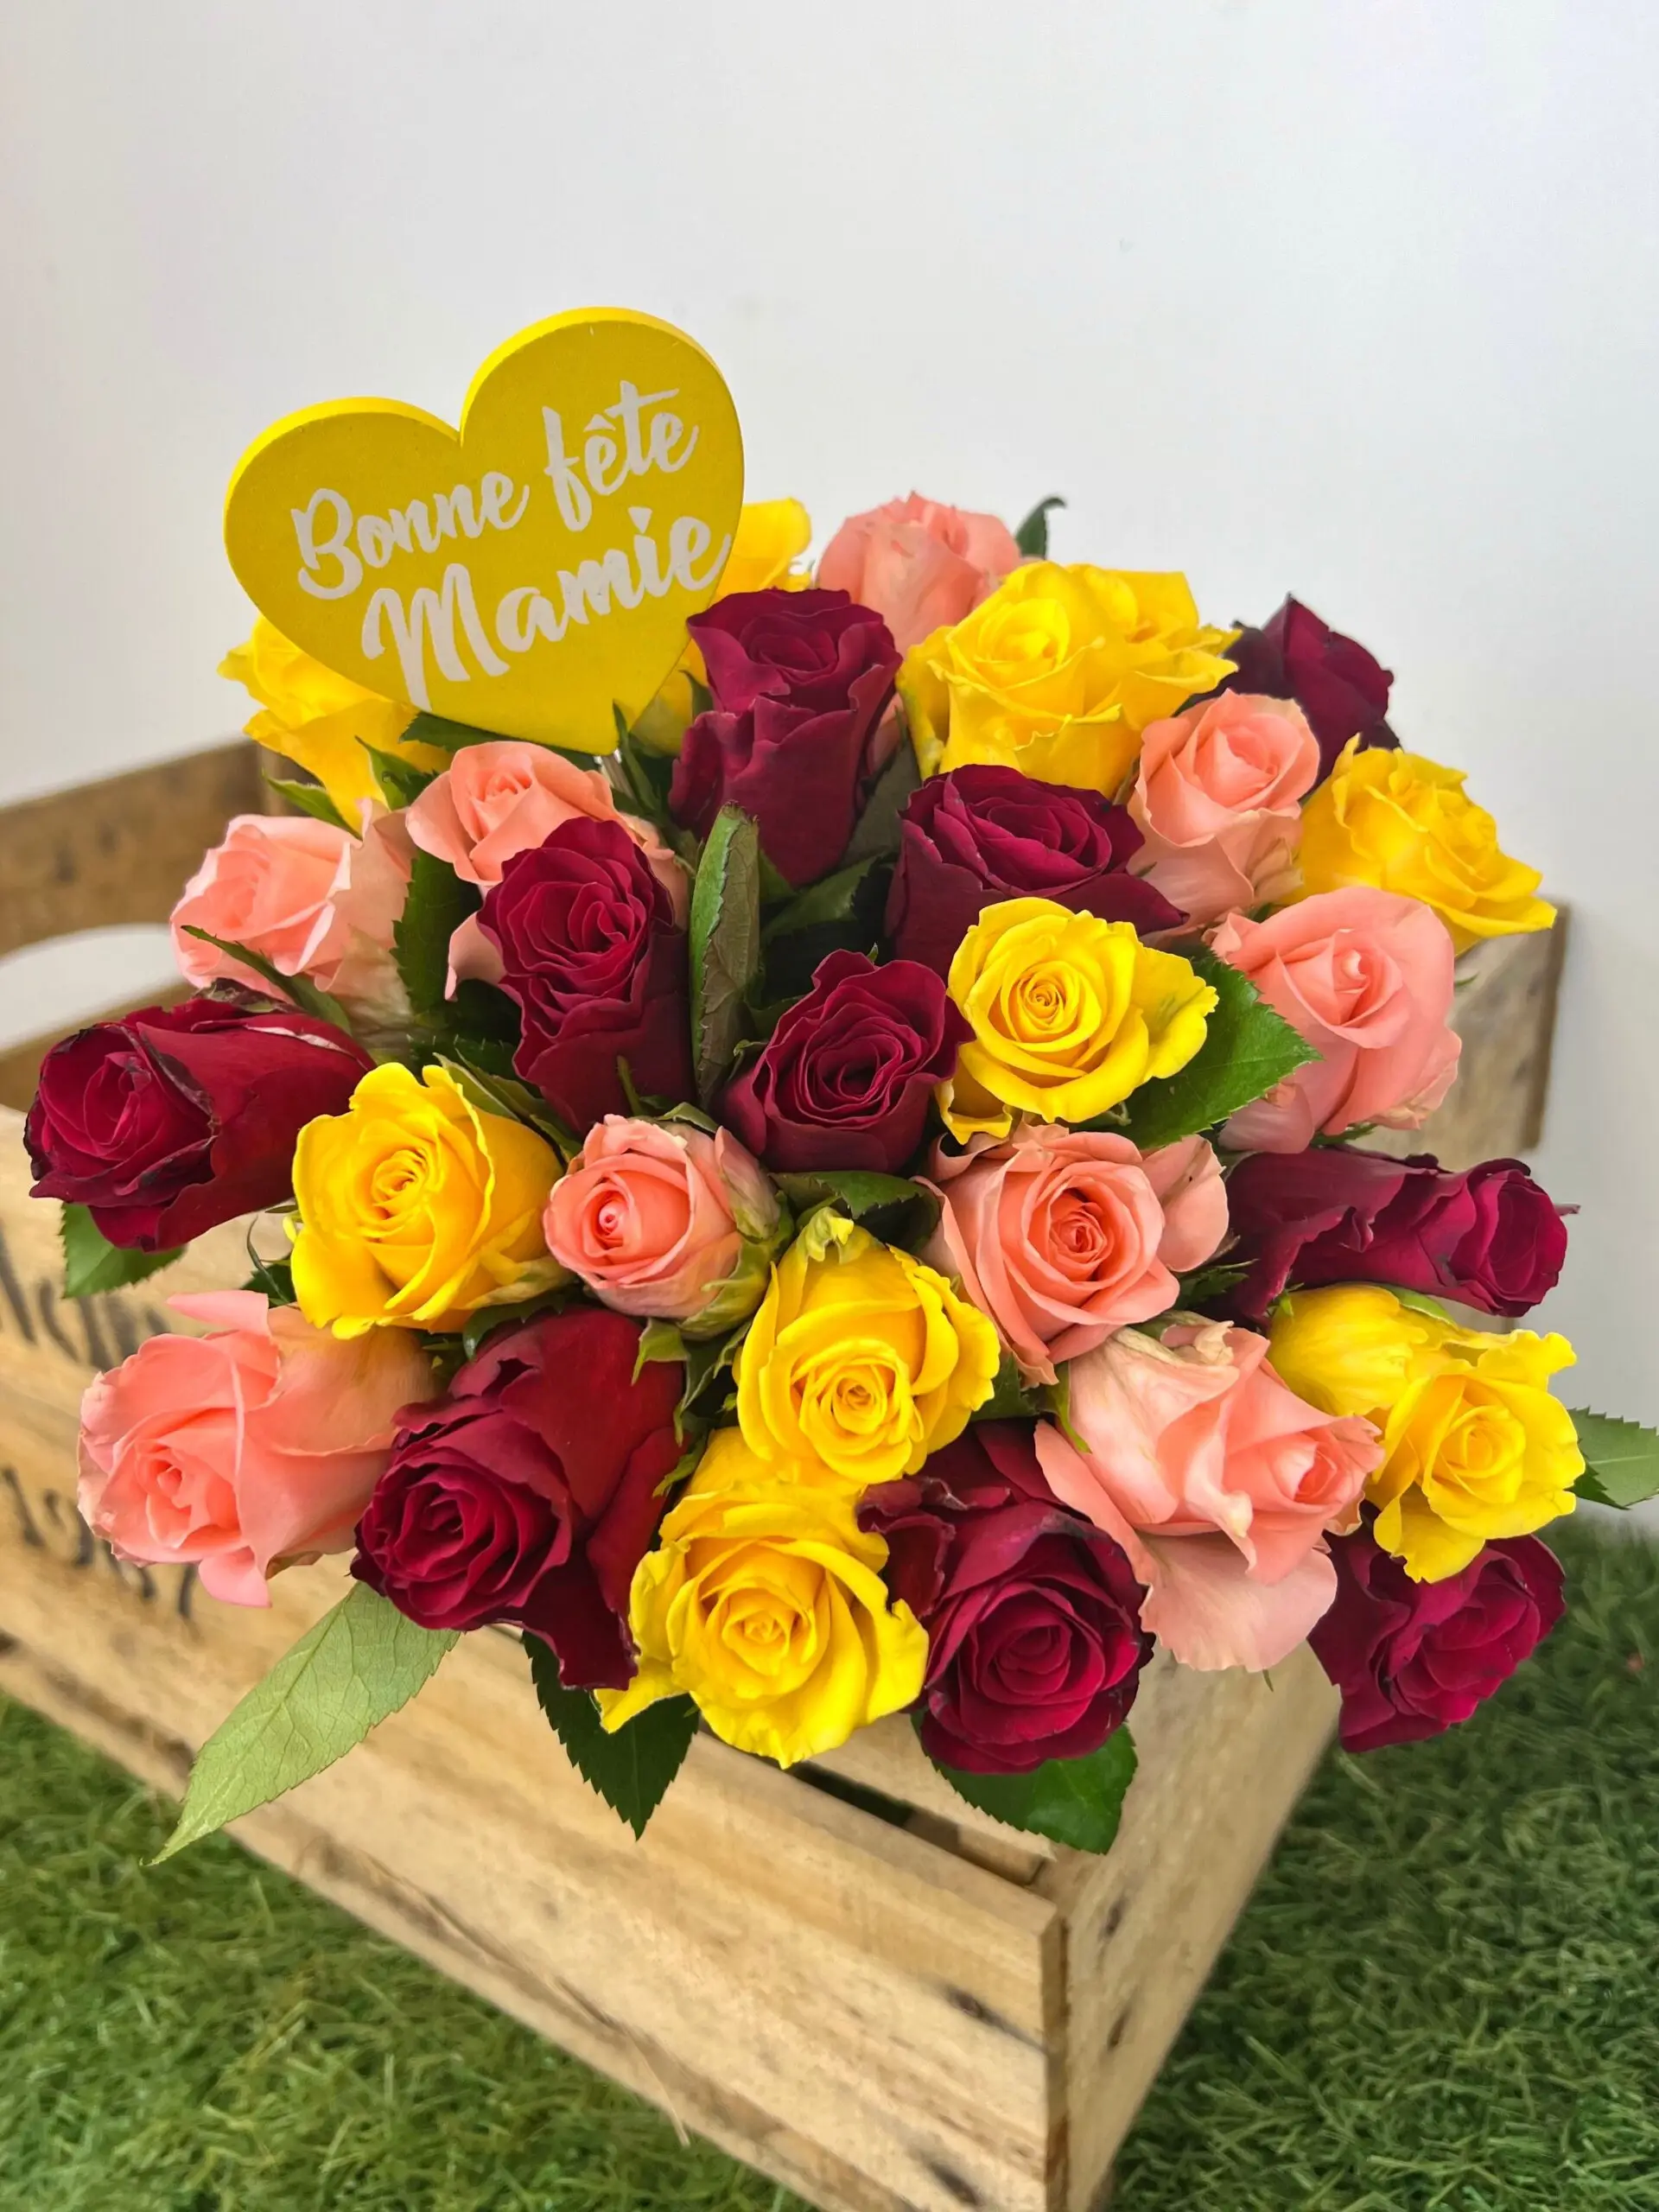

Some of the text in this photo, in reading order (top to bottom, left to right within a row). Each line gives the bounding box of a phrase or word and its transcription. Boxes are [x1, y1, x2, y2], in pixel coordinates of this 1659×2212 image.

[290, 379, 699, 600] Bonne fête
[361, 506, 731, 712] Mamie
